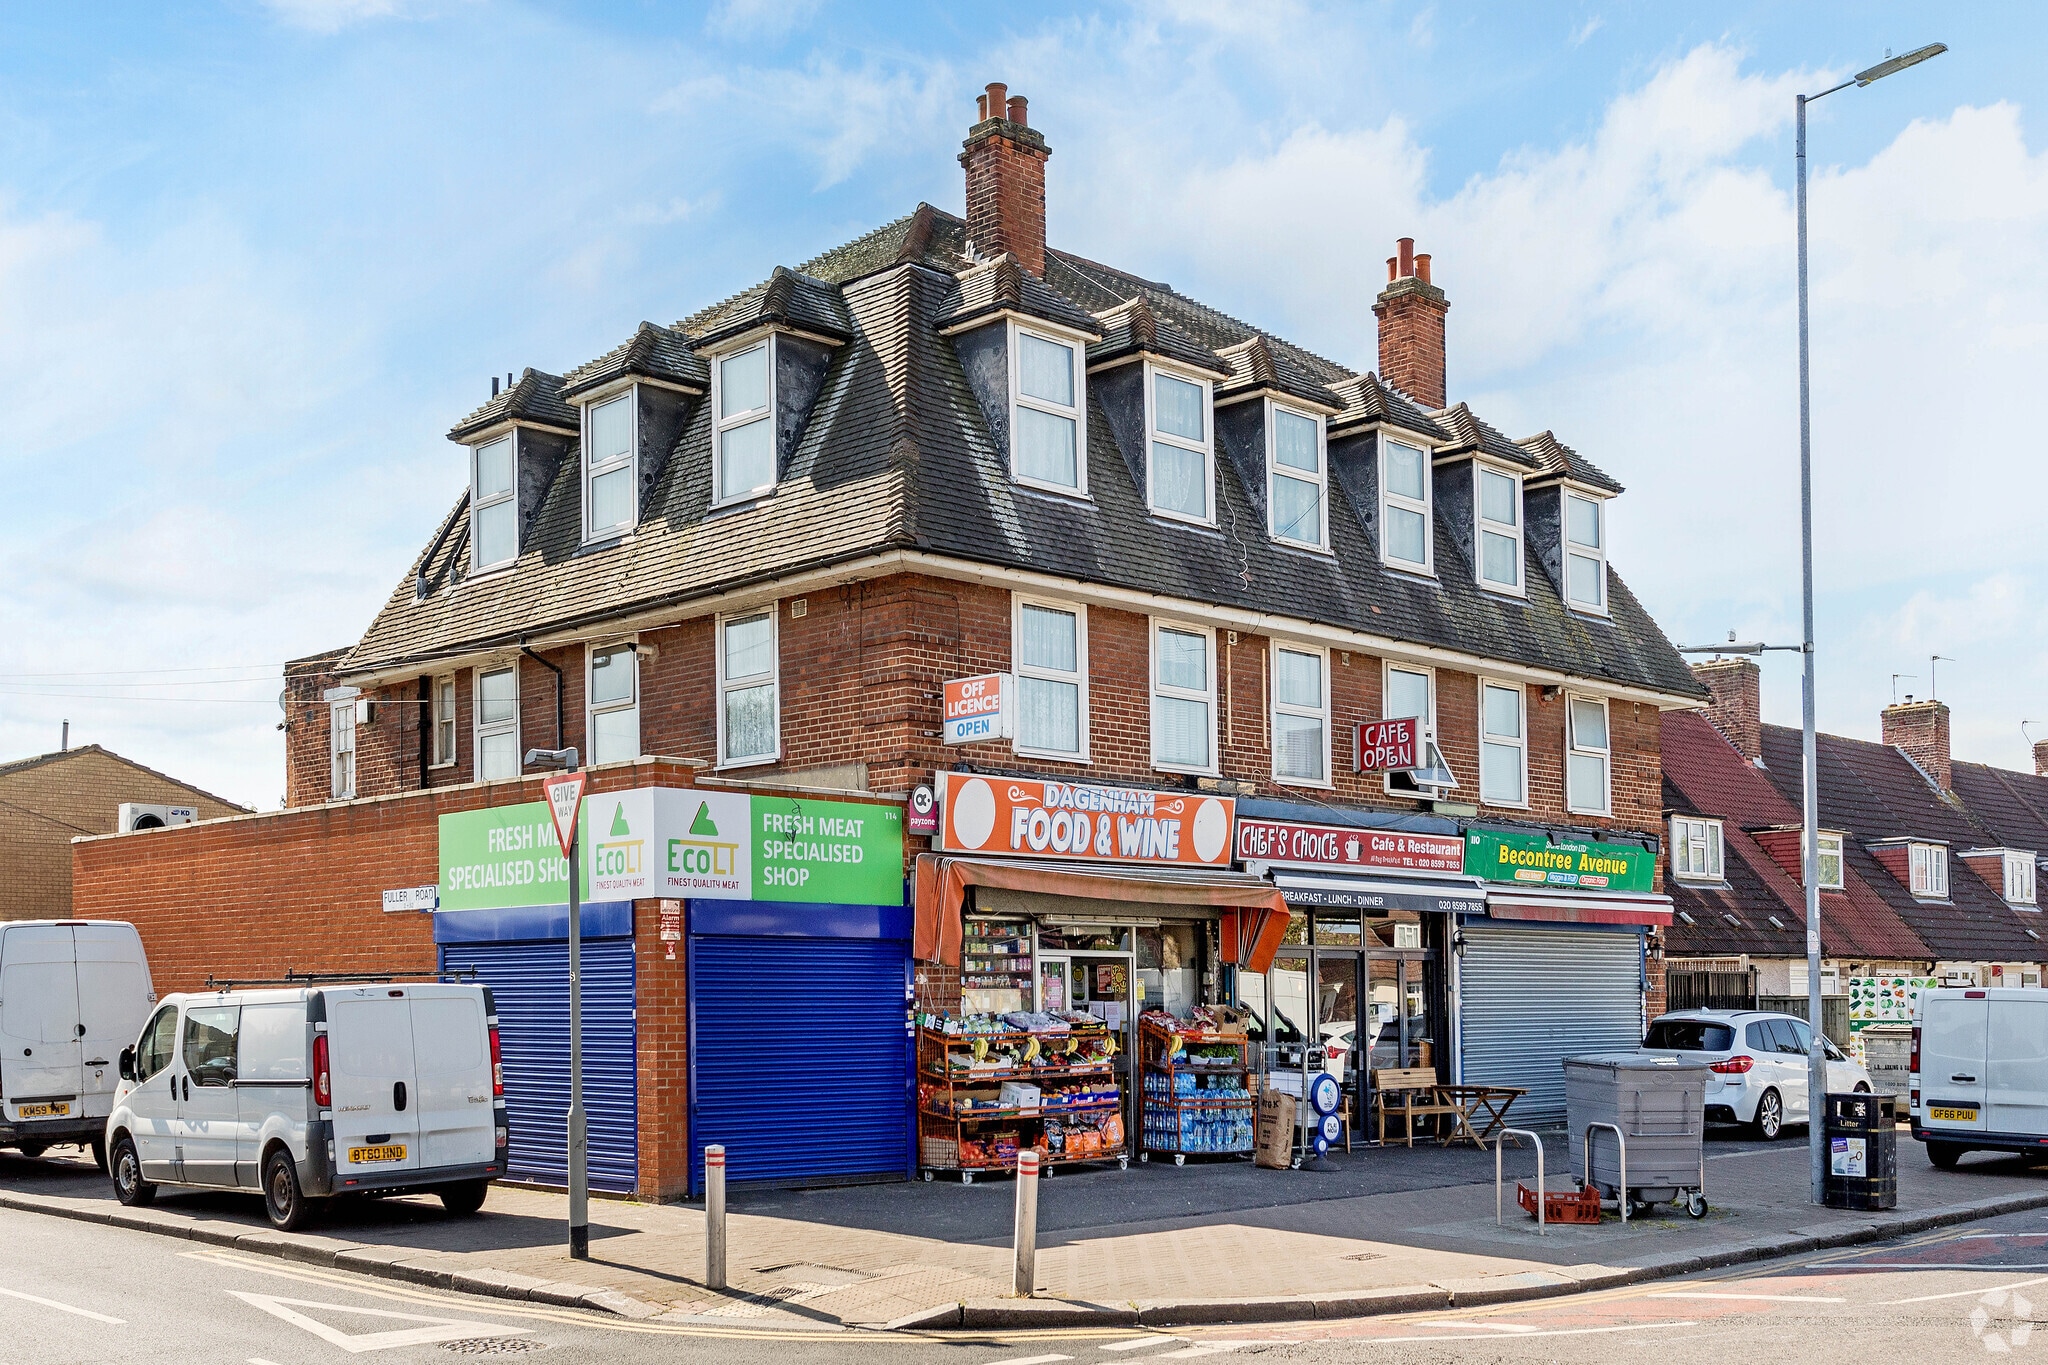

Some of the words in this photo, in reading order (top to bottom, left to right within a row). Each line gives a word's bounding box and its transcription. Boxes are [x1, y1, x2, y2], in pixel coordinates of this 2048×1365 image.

[961, 681, 985, 698] OFF
[948, 694, 998, 716] LICENCE
[957, 719, 989, 736] OPEN
[1365, 722, 1409, 746] CAFE
[1363, 743, 1411, 767] OPEN
[553, 785, 575, 802] GIVE
[1043, 783, 1155, 815] DAGENHAM
[558, 805, 573, 817] WAY
[885, 812, 897, 820] 114
[763, 813, 813, 835] FRESH
[819, 817, 863, 838] MEAT
[911, 817, 935, 826] payzone
[489, 823, 532, 853] FRESH
[1010, 806, 1091, 854] FOOD
[1094, 813, 1112, 856] &
[1117, 816, 1181, 859] WINE
[1471, 836, 1480, 844] 110
[763, 840, 863, 863] SPECIALISED
[1241, 825, 1288, 856] CHEF'S
[1292, 829, 1339, 861] CHOICE
[1371, 836, 1395, 851] Cafe
[1397, 839, 1405, 852] &
[1408, 839, 1461, 856] Restaurant
[1560, 842, 1578, 852] London
[1578, 844, 1587, 853] LTD
[1403, 857, 1413, 866] TEL
[1419, 859, 1430, 867] 020
[1431, 859, 1445, 868] 8599
[1446, 861, 1460, 869] 7855
[1498, 845, 1572, 870] Becontree
[1578, 853, 1628, 875] Avenue
[448, 859, 534, 890] SPECIALISED
[596, 880, 612, 889] FINEST
[612, 878, 632, 888] QUALITY
[633, 877, 645, 886] MEAT
[763, 866, 809, 886] SHOP
[667, 877, 691, 887] FINEST
[692, 879, 721, 889] QUALITY
[722, 881, 739, 890] MEAT
[384, 891, 408, 903] FULLER
[416, 888, 434, 900] ROAD
[1328, 894, 1352, 905] LUNCH
[1358, 895, 1384, 906] DINNER
[1439, 900, 1451, 910] 020
[1452, 901, 1467, 911] 8599
[1468, 902, 1483, 912] 7855
[23, 1105, 47, 1116] KM59
[1934, 1109, 1955, 1119] GF66
[1956, 1110, 1974, 1119] PUU
[383, 1146, 403, 1158] HND
